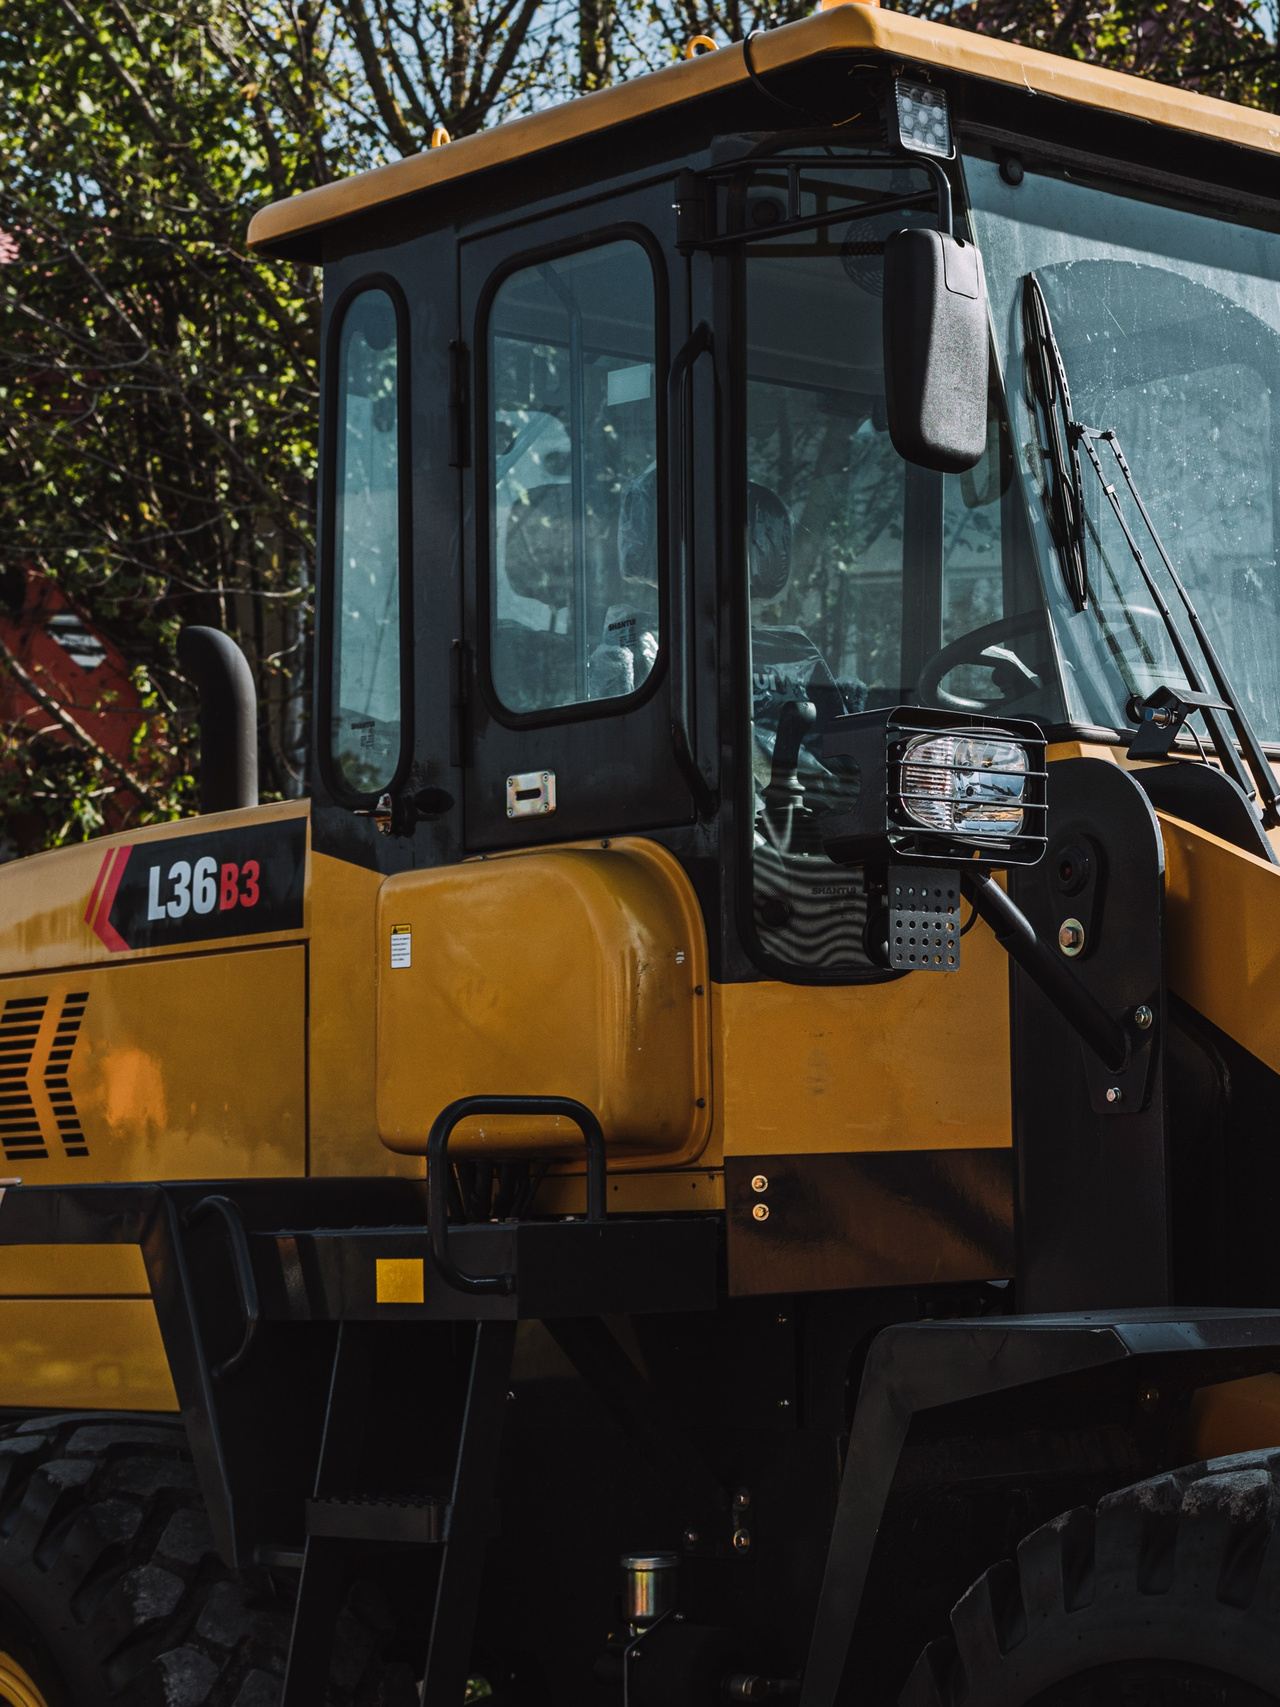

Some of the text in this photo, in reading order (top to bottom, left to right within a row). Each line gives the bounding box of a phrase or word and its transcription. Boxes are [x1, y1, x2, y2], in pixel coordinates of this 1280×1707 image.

[608, 618, 637, 632] SHANTUI
[147, 856, 260, 921] L36B3
[811, 886, 857, 895] SHANTUI
